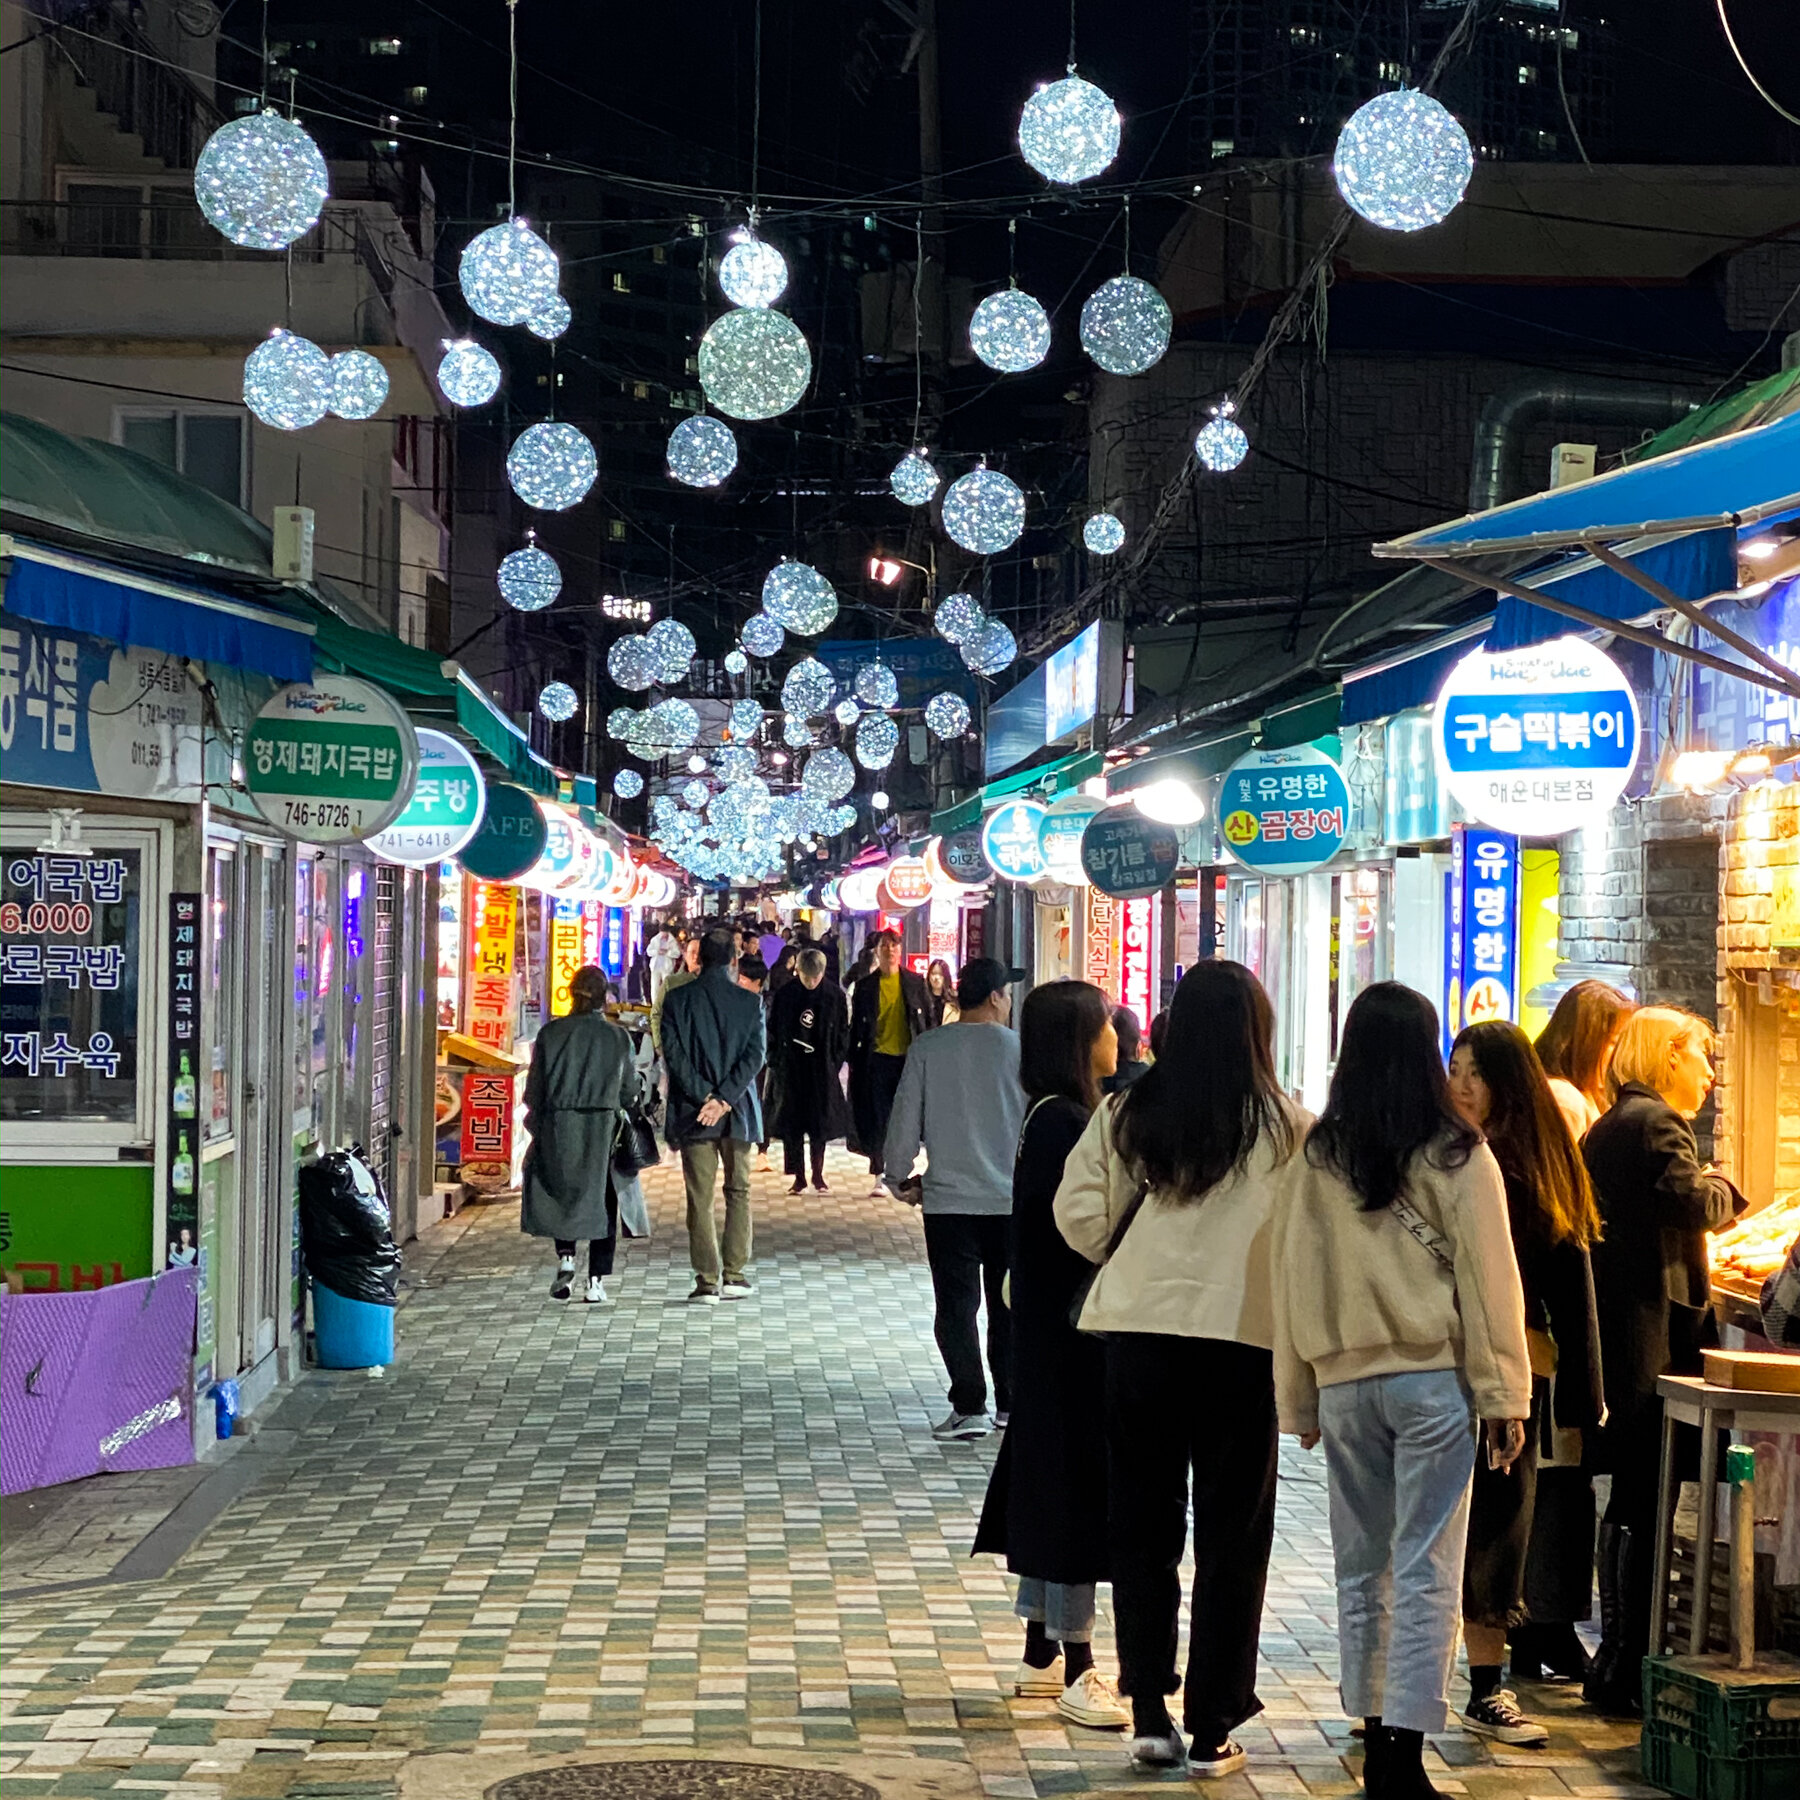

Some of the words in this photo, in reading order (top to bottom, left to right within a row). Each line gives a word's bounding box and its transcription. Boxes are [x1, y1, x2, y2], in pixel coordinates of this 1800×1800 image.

[1454, 710, 1625, 754] 구슬떡볶이
[252, 737, 397, 781] 형제돼지국밥
[401, 778, 471, 814] 주방
[1239, 778, 1252, 803] 원조
[1256, 773, 1328, 802] 유명한
[285, 801, 350, 828] 746-8726
[481, 816, 535, 838] AFE
[1228, 814, 1255, 842] 산
[1259, 806, 1344, 842] 곰장어
[378, 832, 451, 848] 741-6418
[1088, 841, 1146, 871] 참기름
[1472, 841, 1509, 972] 유명한
[0, 945, 125, 990] 로국밥
[175, 902, 193, 1039] 형제돼지국밥
[469, 1079, 509, 1153] 족발
